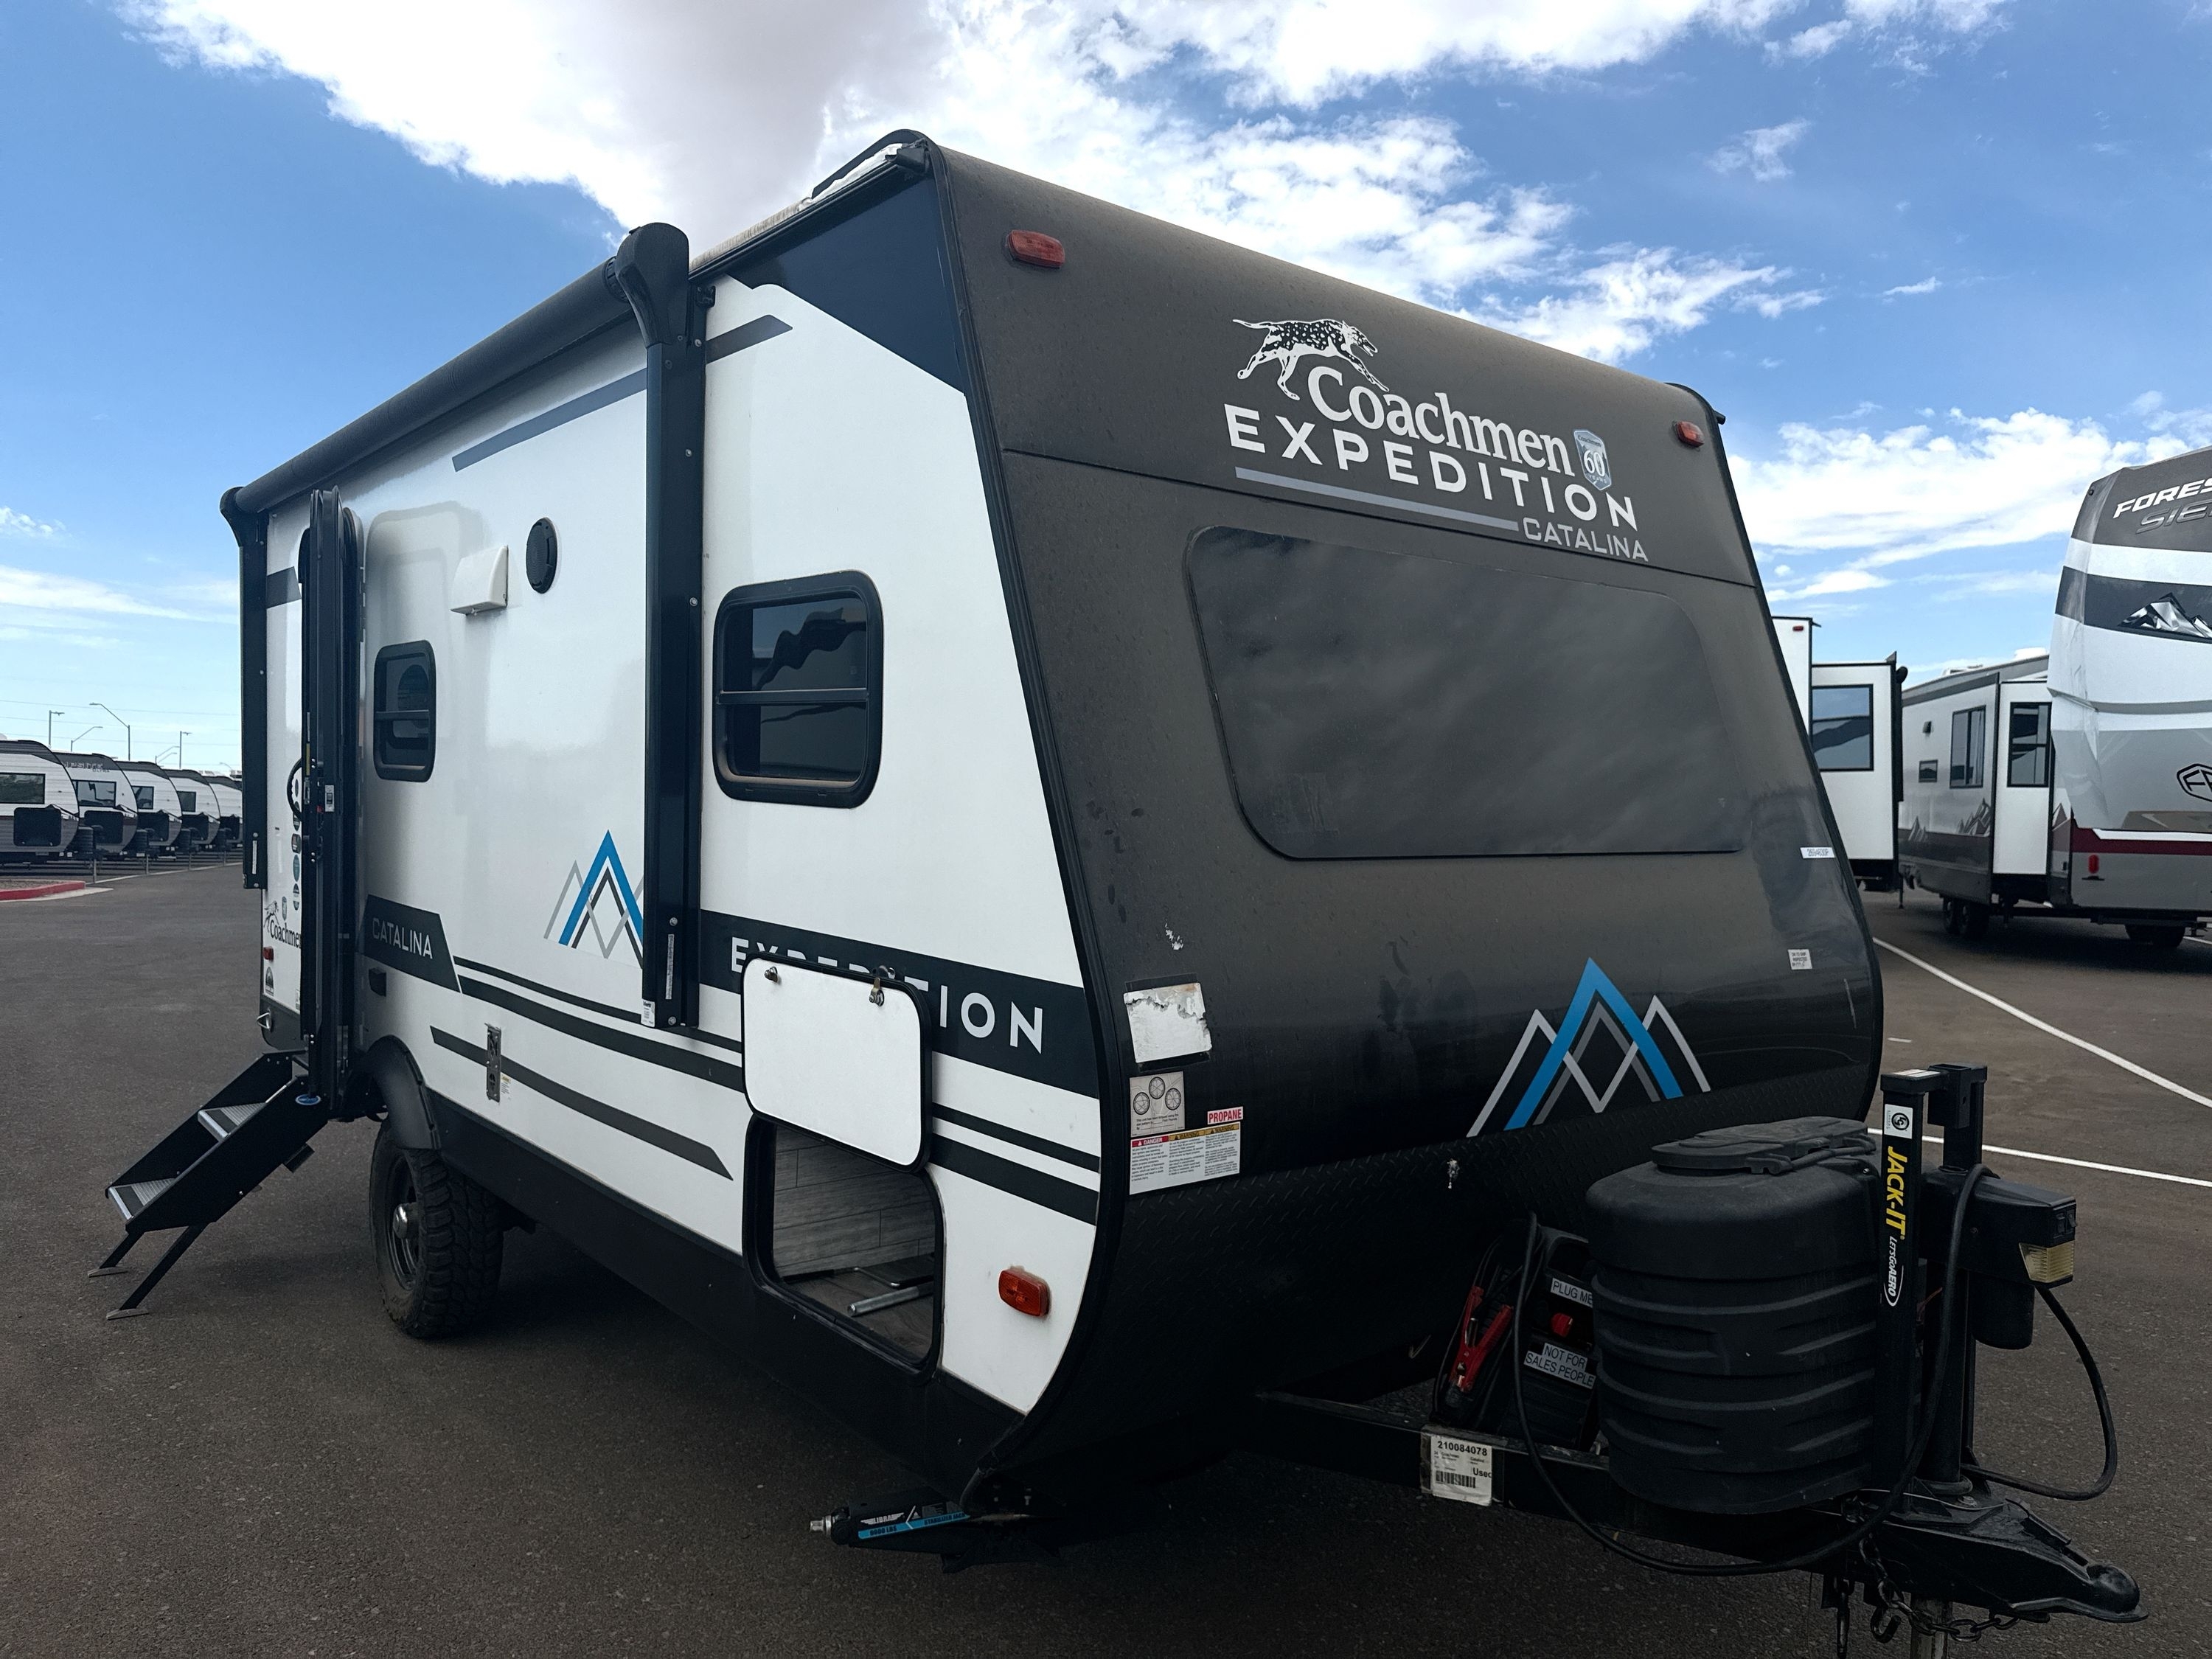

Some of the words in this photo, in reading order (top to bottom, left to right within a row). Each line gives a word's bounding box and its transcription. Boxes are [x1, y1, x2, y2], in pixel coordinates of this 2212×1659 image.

[1308, 366, 1575, 476] Coachmen
[1223, 403, 1638, 532] EXPEDITION
[1583, 450, 1605, 477] 60
[1523, 516, 1649, 562] CATALINA
[372, 917, 433, 959] CATALINA
[1208, 1109, 1242, 1123] PROPANE
[1143, 1137, 1163, 1145] DANGER
[1552, 1280, 1578, 1299] PLUG
[1579, 1290, 1593, 1305] ME
[1526, 1352, 1557, 1373] SALES
[1558, 1366, 1594, 1387] PEOPLE
[1544, 1345, 1565, 1361] NOT
[1565, 1354, 1585, 1369] FOR
[1438, 1441, 1487, 1456] 210084078
